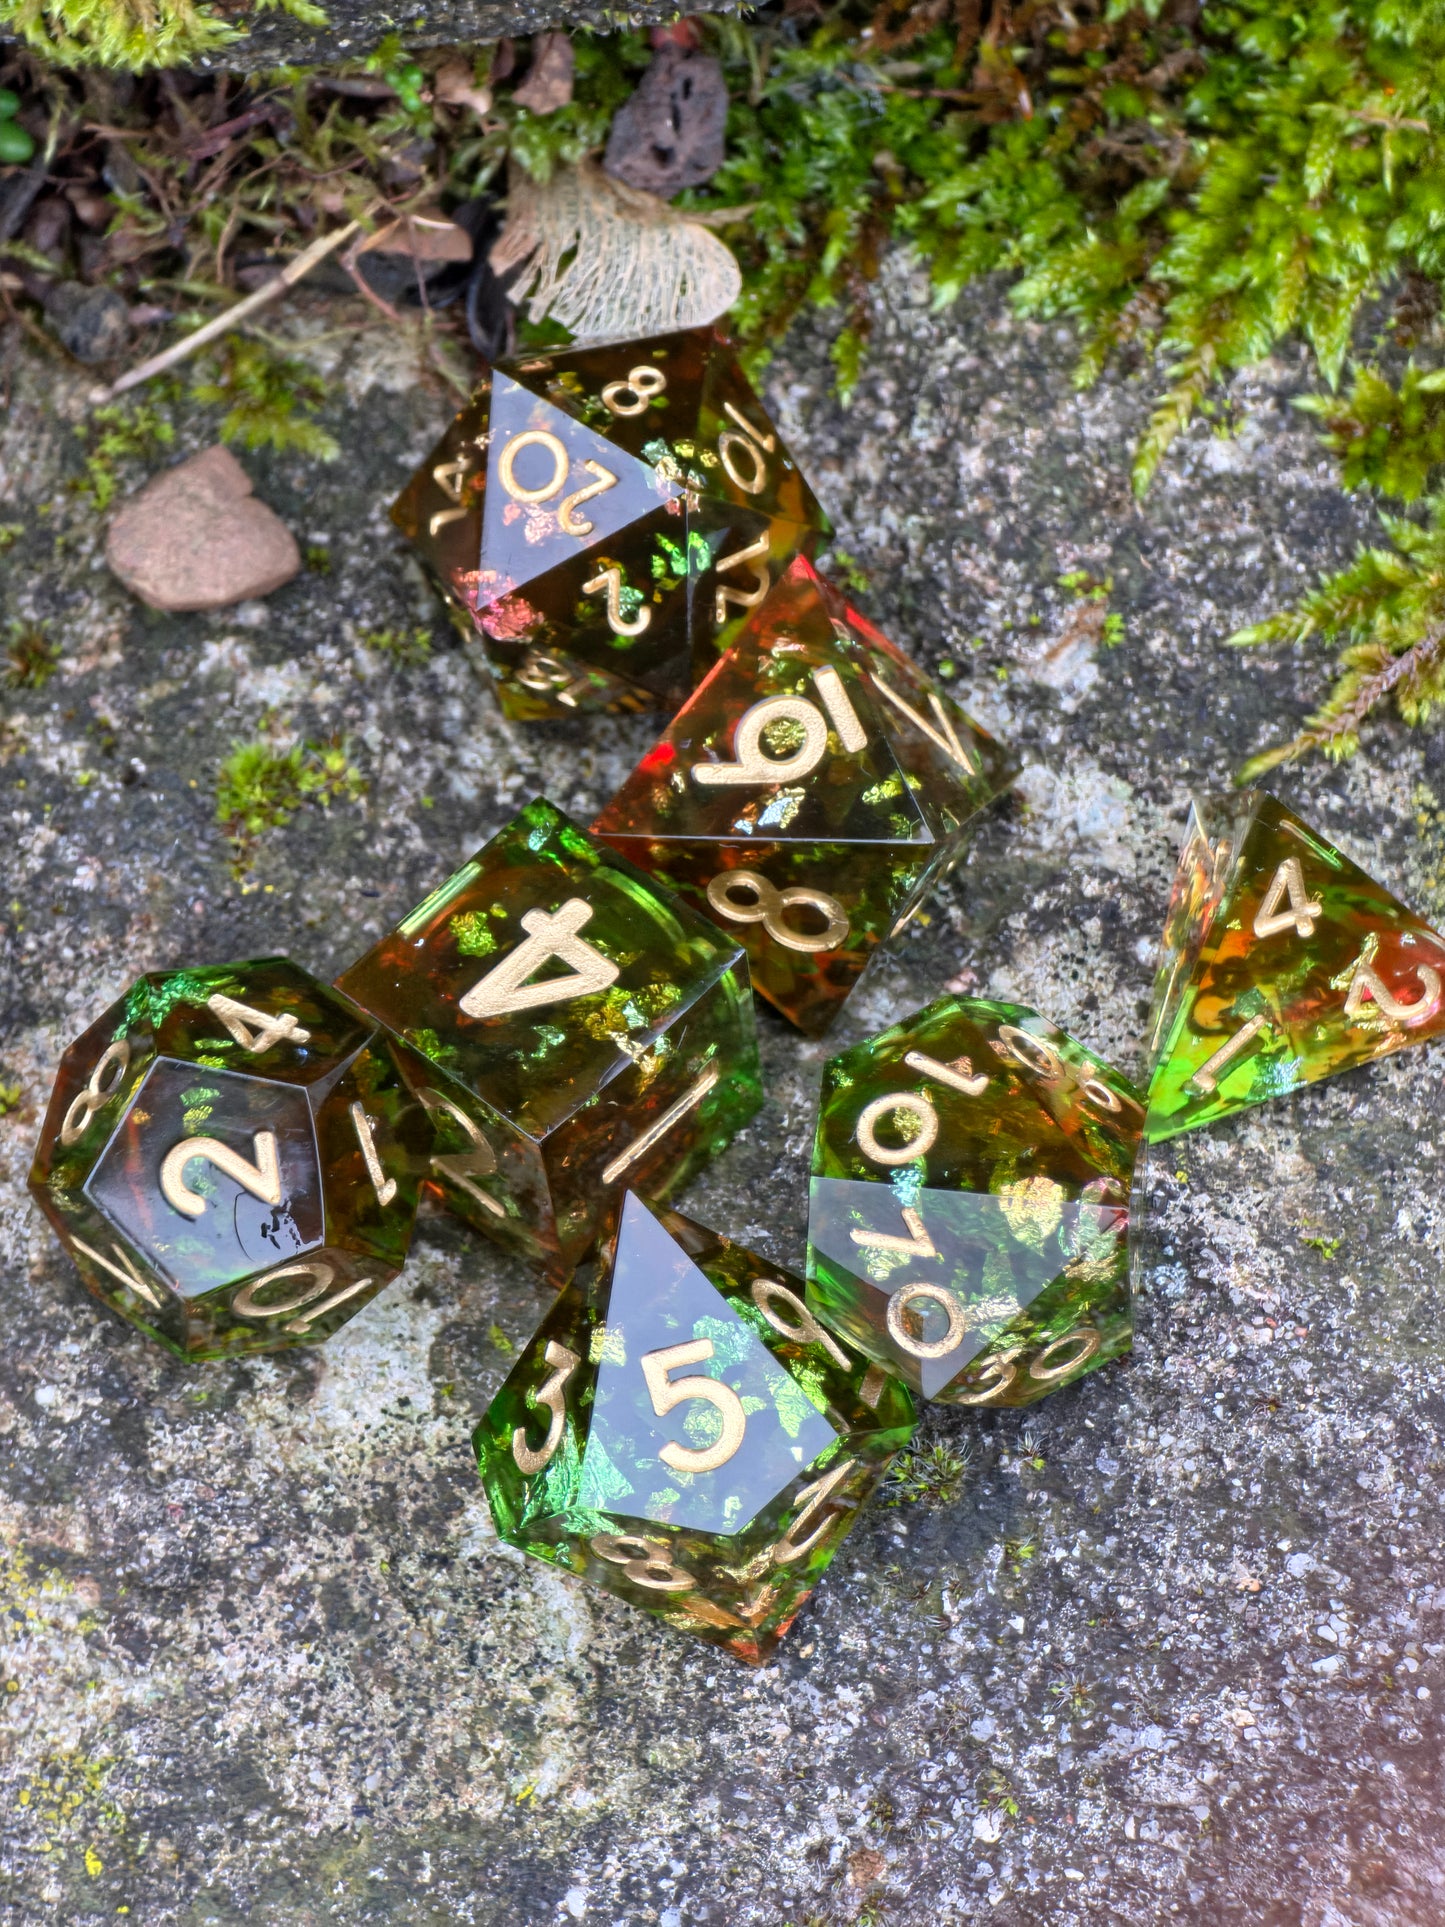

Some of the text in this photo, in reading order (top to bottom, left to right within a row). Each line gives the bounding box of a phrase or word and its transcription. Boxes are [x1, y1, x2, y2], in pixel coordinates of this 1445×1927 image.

[602, 365, 667, 416] 8
[499, 430, 619, 536] 20
[718, 402, 776, 494] 10
[582, 567, 651, 636] 2
[715, 530, 770, 623] 12
[869, 671, 975, 776] 7
[707, 869, 850, 953] 8
[1253, 856, 1322, 938] 4
[459, 898, 621, 1018] 4
[1344, 963, 1441, 1021] 2
[208, 993, 311, 1053] 4
[1192, 1014, 1266, 1092] 1
[61, 1040, 130, 1146] 8
[602, 1057, 720, 1184] 1
[856, 1050, 990, 1165] 10
[161, 1131, 281, 1216] 2
[348, 1101, 398, 1207] 1
[415, 1086, 506, 1219] 2
[751, 1278, 853, 1373] 9
[849, 1207, 965, 1359] 70
[513, 1340, 581, 1474] 3
[641, 1337, 747, 1473] 5
[958, 1327, 1100, 1404] 30
[590, 1534, 698, 1592] 8
